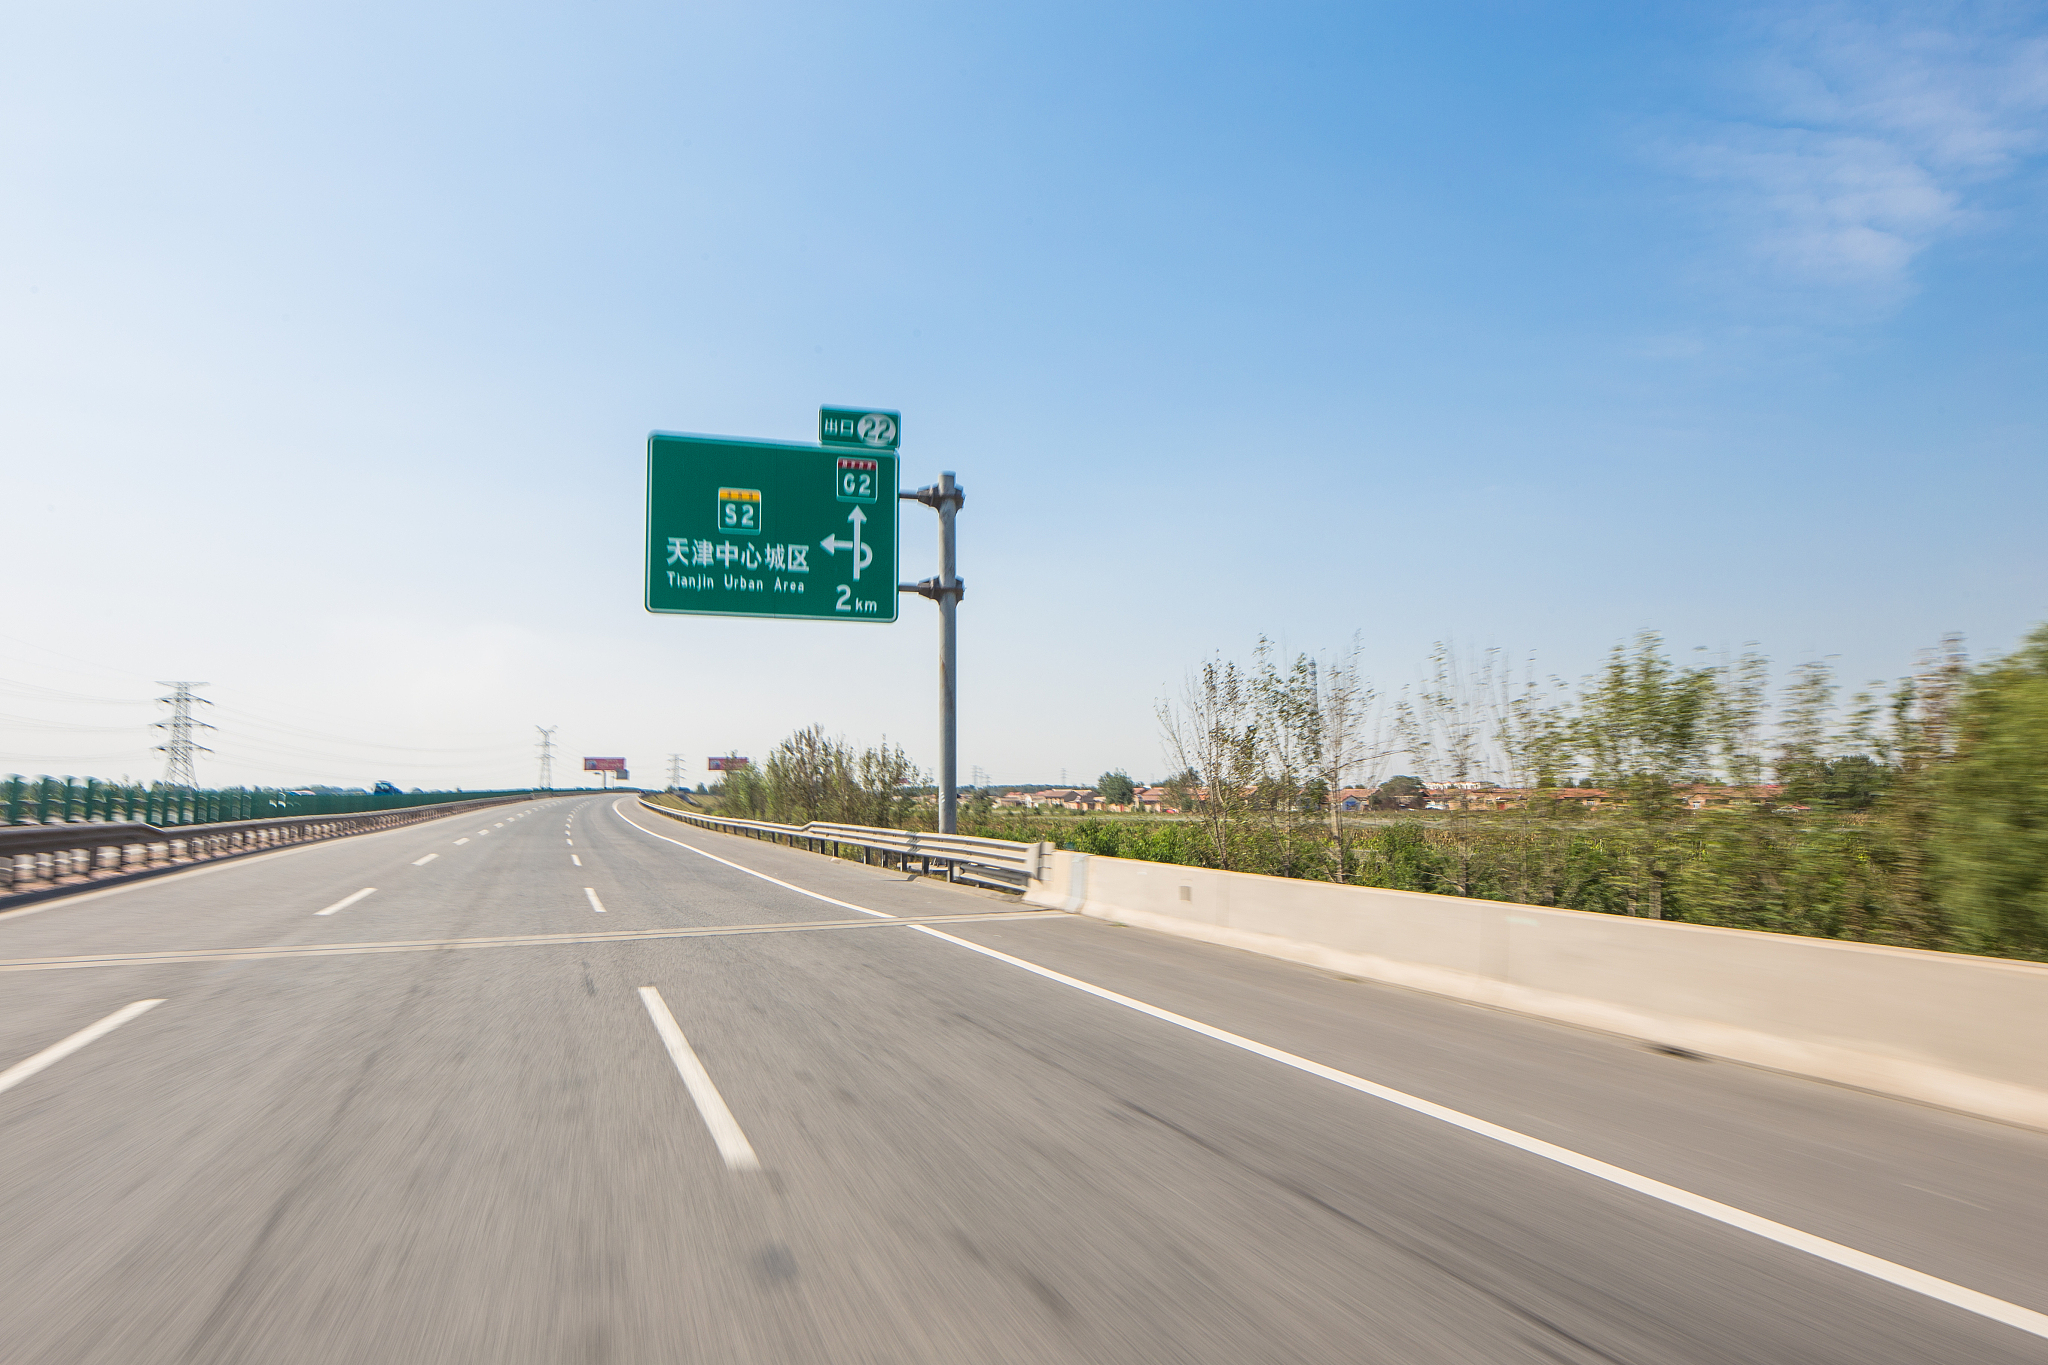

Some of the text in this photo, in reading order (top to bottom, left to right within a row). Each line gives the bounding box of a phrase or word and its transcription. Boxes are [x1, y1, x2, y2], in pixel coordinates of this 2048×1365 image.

[824, 416, 891, 442] 出口 22
[843, 472, 870, 497] G2
[725, 502, 754, 528] S2
[666, 536, 810, 573] 天津中心城区
[666, 570, 805, 594] Tianjin Urban Area
[835, 583, 878, 613] 2 km
